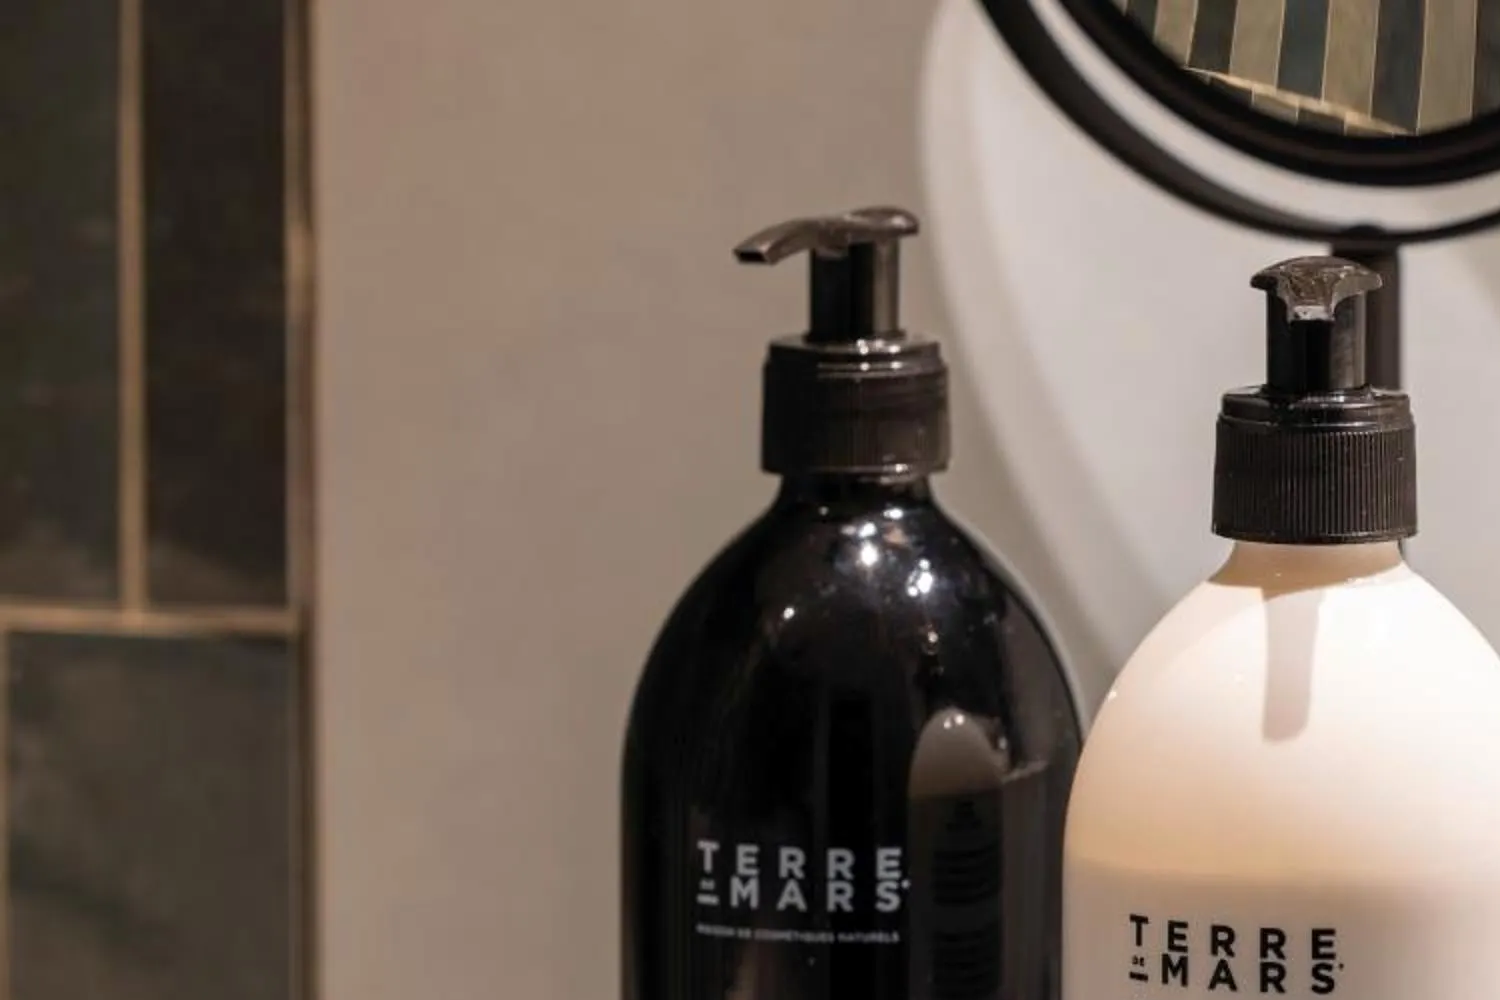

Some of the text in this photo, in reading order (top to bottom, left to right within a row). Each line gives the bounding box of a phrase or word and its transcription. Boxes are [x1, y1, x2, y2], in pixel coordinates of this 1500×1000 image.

[697, 840, 902, 880] TERRE
[730, 875, 901, 912] MARS
[1129, 913, 1337, 960] TERRE
[1131, 955, 1146, 966] DE
[1161, 952, 1336, 995] MARS
